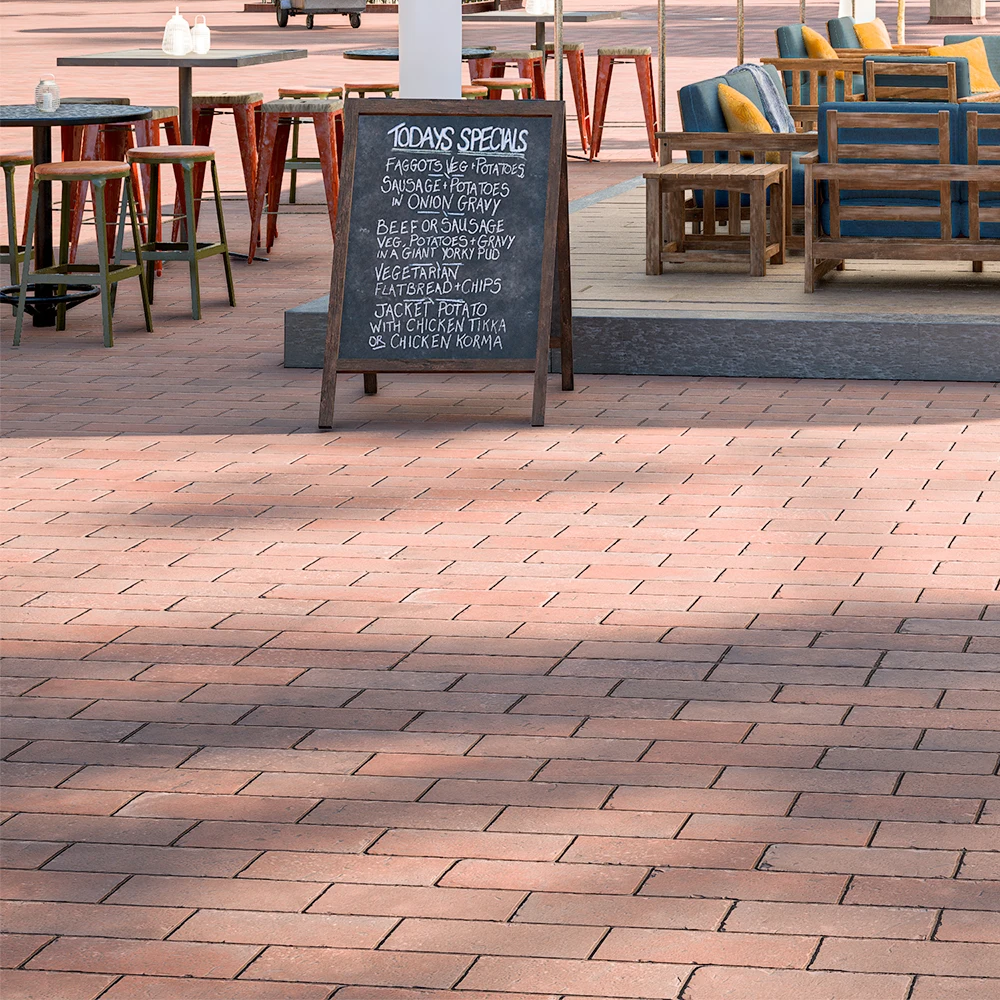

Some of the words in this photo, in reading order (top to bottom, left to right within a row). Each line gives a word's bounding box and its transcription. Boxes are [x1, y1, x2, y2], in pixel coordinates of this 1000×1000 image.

[387, 122, 455, 150] TODAYS
[457, 126, 529, 153] SPECIALS
[385, 157, 443, 173] FAGGOTS
[445, 156, 469, 173] VEG
[475, 157, 526, 178] POTATOES
[380, 175, 442, 194] SAUSAGE
[449, 177, 510, 198] POTATOES
[392, 196, 403, 207] IN
[407, 193, 453, 210] ONION
[457, 195, 501, 217] GRAVY
[376, 219, 418, 235] BEEF
[421, 218, 438, 234] OR
[440, 217, 505, 234] SAUSAGE
[409, 234, 468, 248] POTATOES
[477, 234, 516, 249] GRAVY
[376, 249, 387, 259] IN
[390, 249, 399, 260] A
[402, 247, 437, 260] GIANT
[442, 247, 475, 261] YORKY
[477, 247, 501, 261] PUD
[374, 262, 460, 281] VEGETARIAN
[374, 280, 453, 297] FLATBREAD
[461, 278, 502, 294] CHIPS
[374, 301, 431, 320] JACKET
[437, 301, 488, 318] POTATO
[369, 320, 401, 333] WITH
[406, 318, 465, 334] CHICKEN
[468, 318, 507, 333] TIKKA
[368, 335, 386, 347] OR
[390, 334, 452, 349] CHICKEN
[455, 334, 503, 350] KORMA
